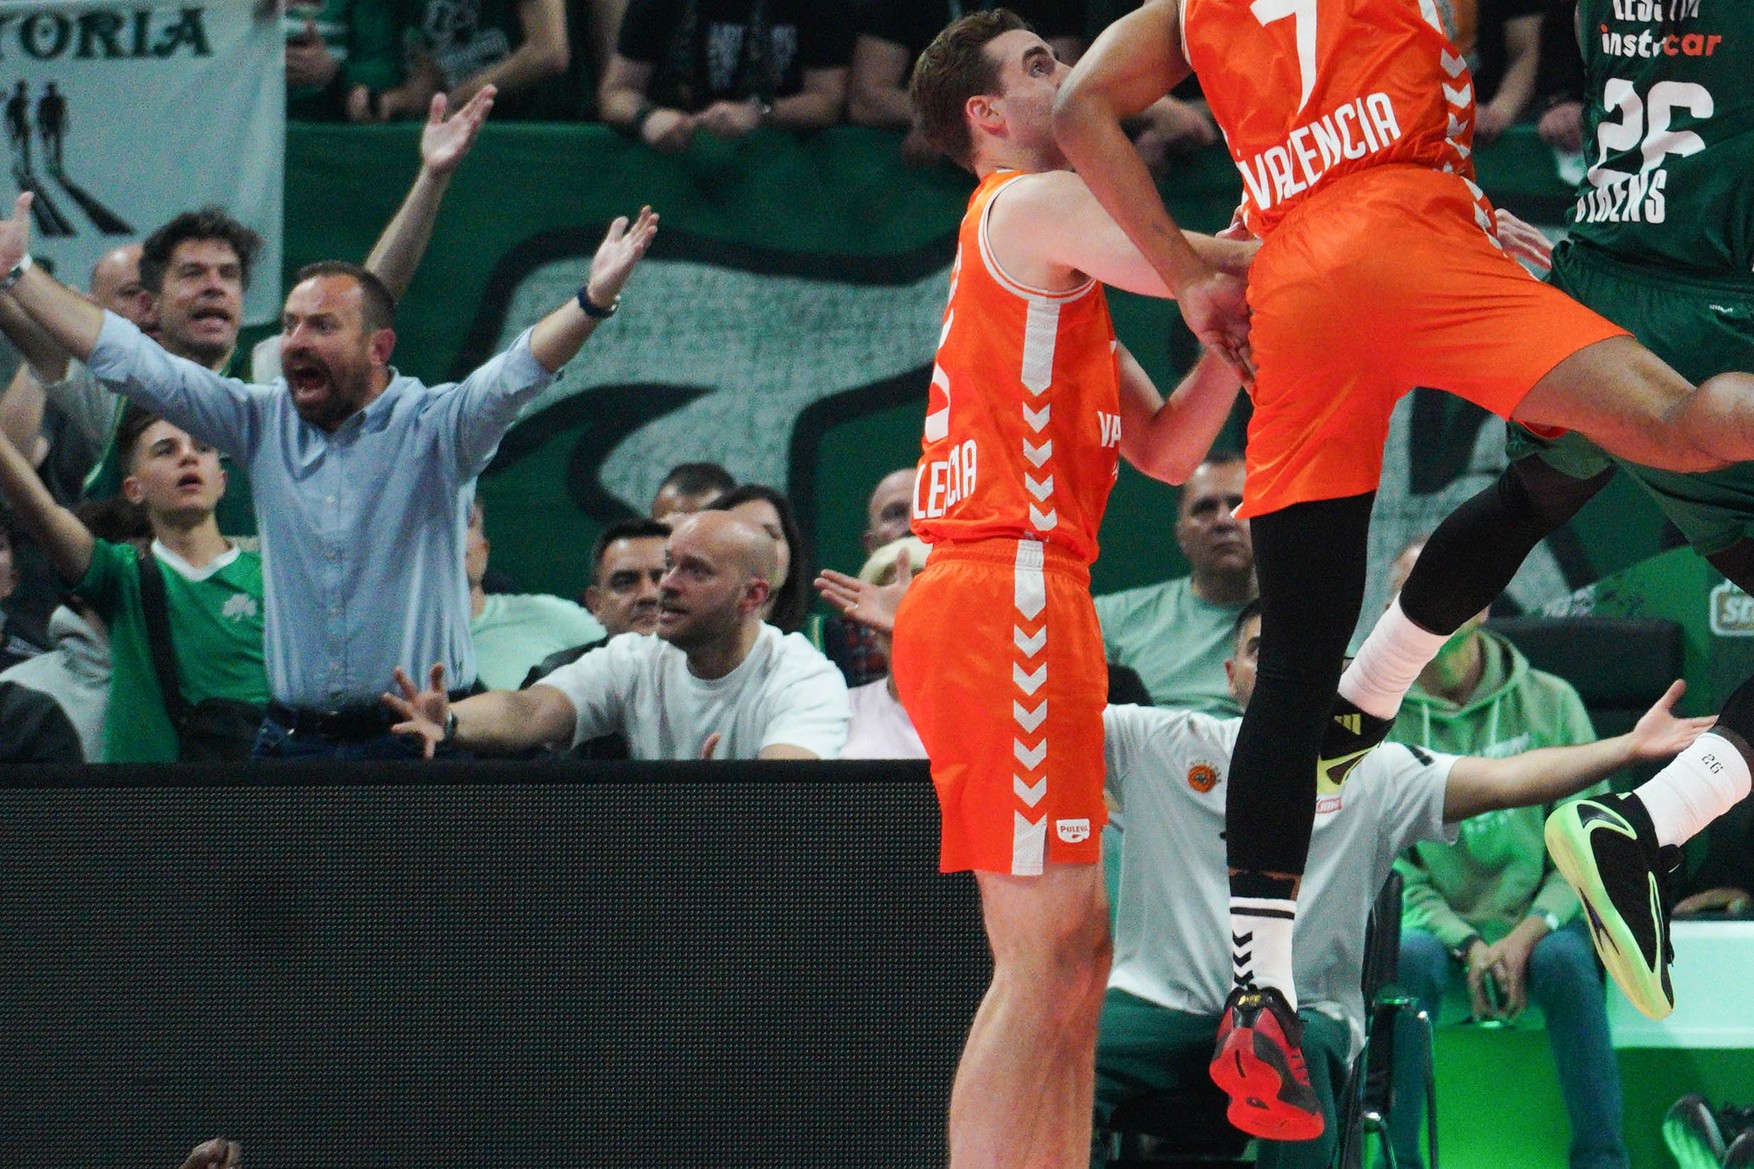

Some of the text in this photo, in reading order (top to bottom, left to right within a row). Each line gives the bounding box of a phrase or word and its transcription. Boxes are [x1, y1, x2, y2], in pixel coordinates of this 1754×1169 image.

[0, 6, 212, 59] ORIA
[1600, 23, 1722, 58] instcar
[1239, 92, 1401, 210] VALENCIA
[1587, 77, 1714, 189] 26
[912, 438, 977, 520] LECIA
